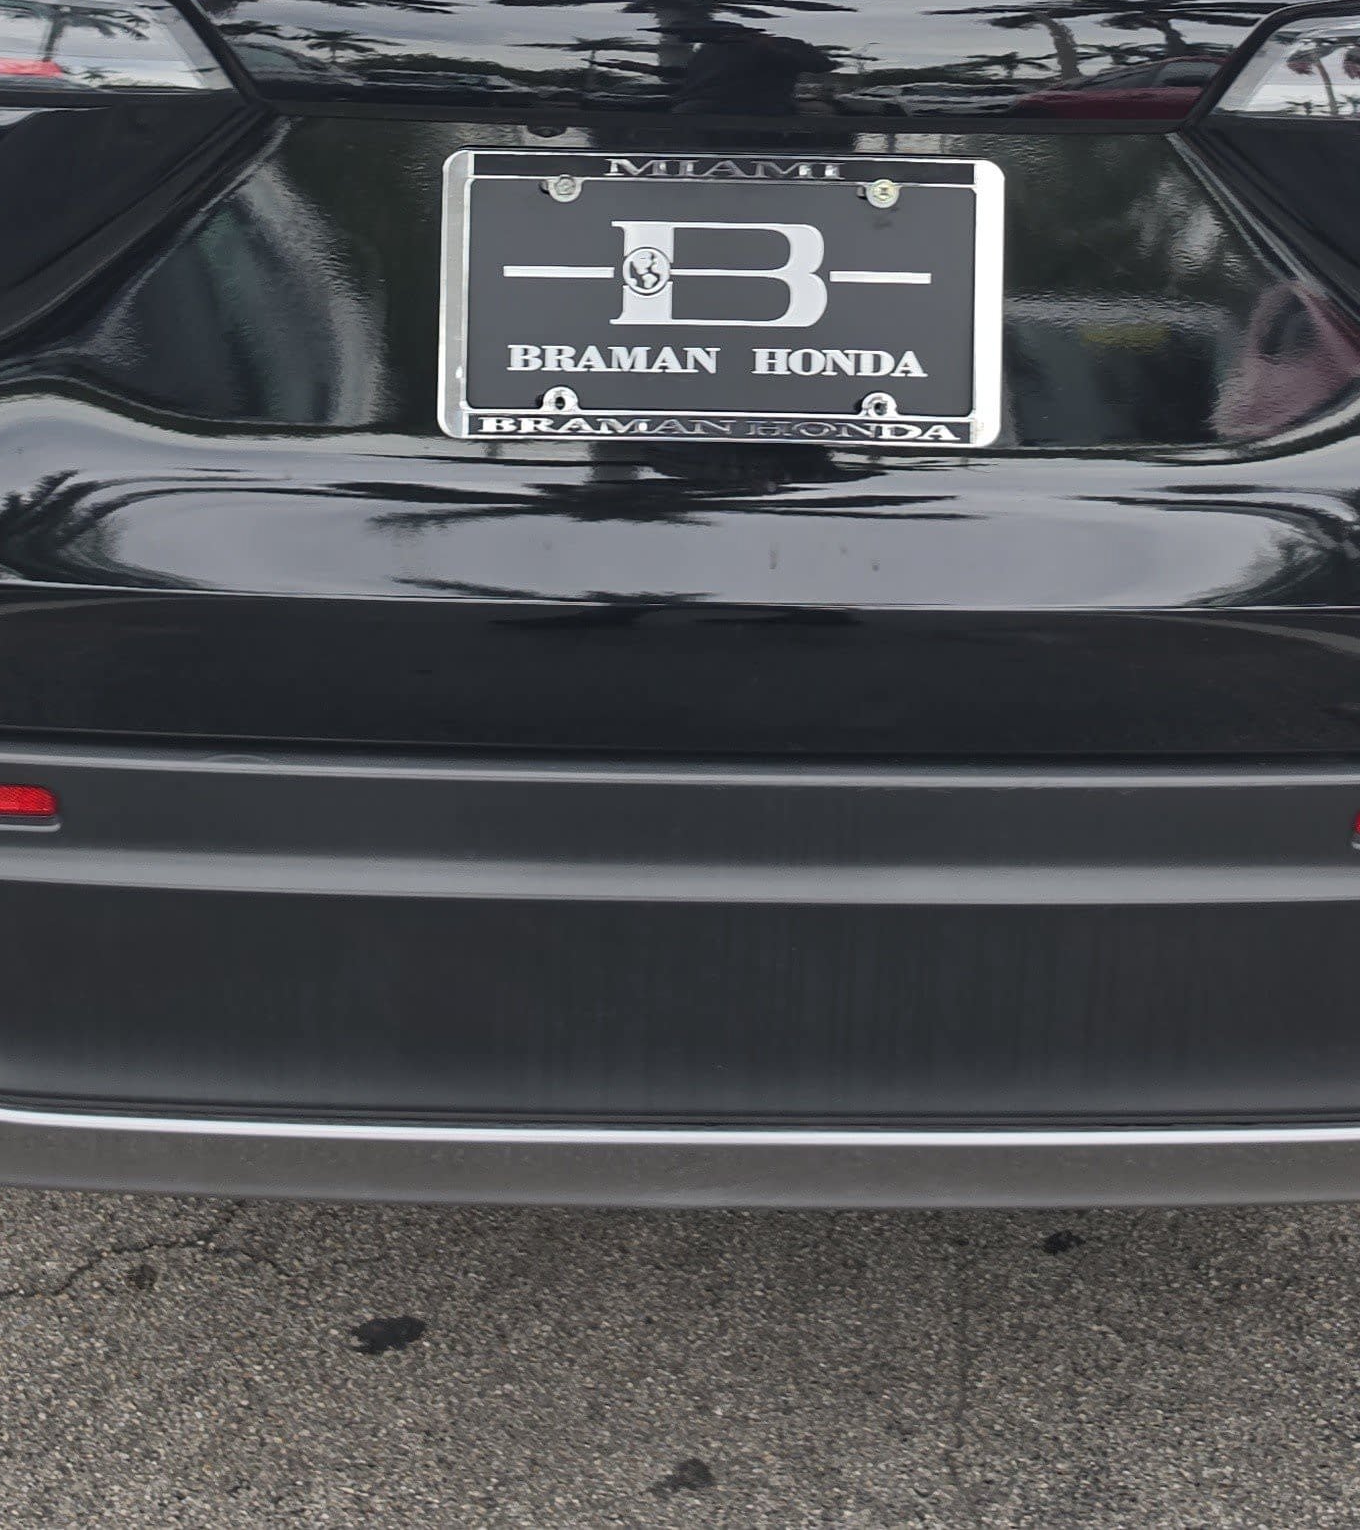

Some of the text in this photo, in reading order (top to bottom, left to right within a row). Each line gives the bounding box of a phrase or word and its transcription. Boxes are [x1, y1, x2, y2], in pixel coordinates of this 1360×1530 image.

[605, 158, 845, 180] MIAMI
[609, 220, 829, 328] B
[507, 344, 928, 378] BRAMAN HONDA
[478, 416, 960, 442] BRAMAN HONDA
